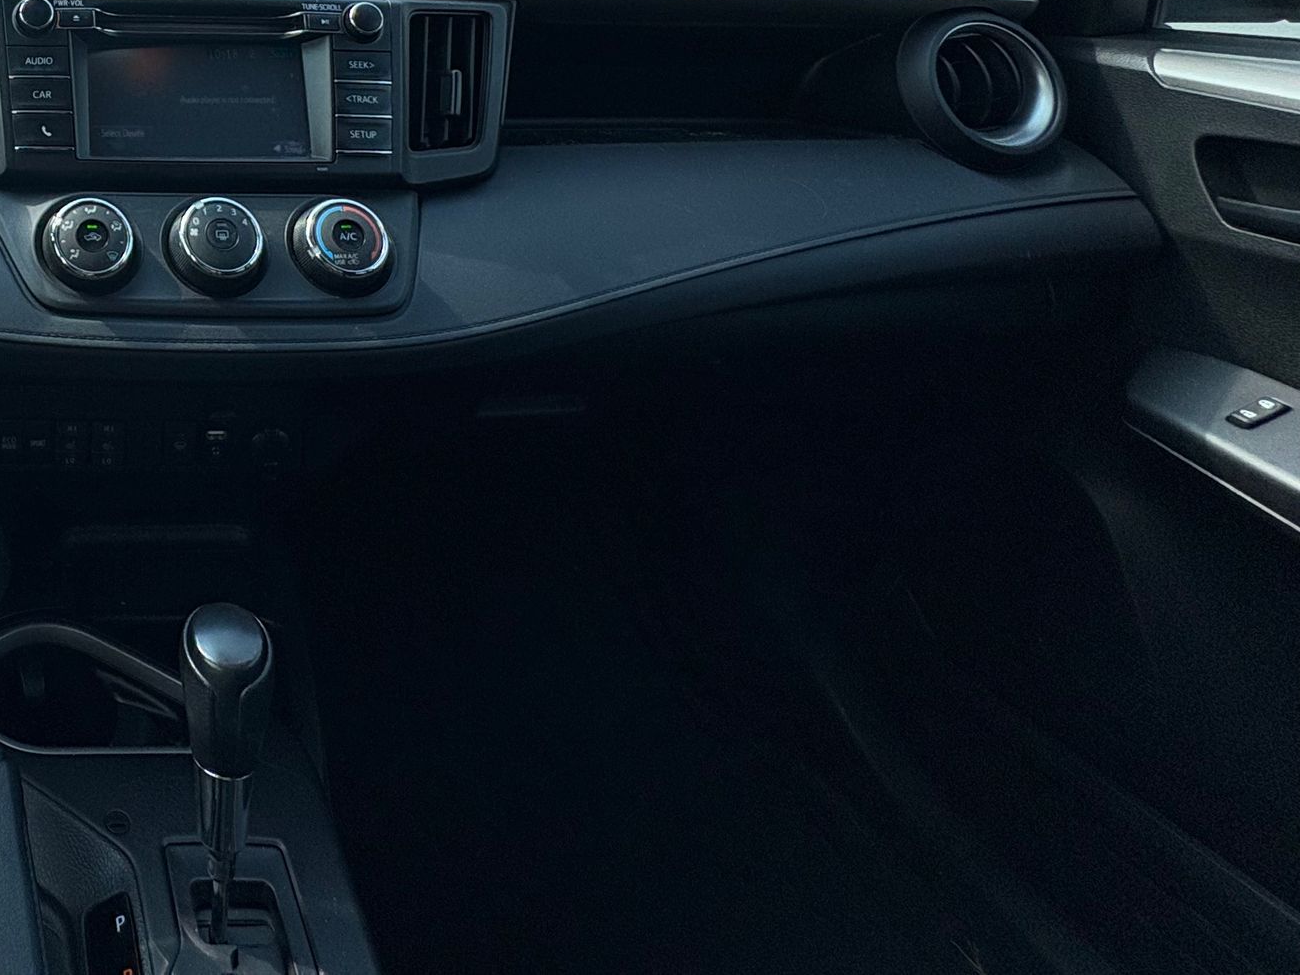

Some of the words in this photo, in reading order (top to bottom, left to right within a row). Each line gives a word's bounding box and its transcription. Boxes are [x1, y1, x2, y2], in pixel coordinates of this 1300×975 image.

[25, 56, 53, 66] AUDIO
[32, 90, 53, 100] CAR
[349, 130, 378, 139] SETUP
[203, 208, 208, 216] 1
[216, 205, 223, 213] 2
[230, 208, 237, 216] 3
[242, 218, 249, 226] 4
[340, 232, 358, 241] A/C
[115, 915, 125, 933] P
